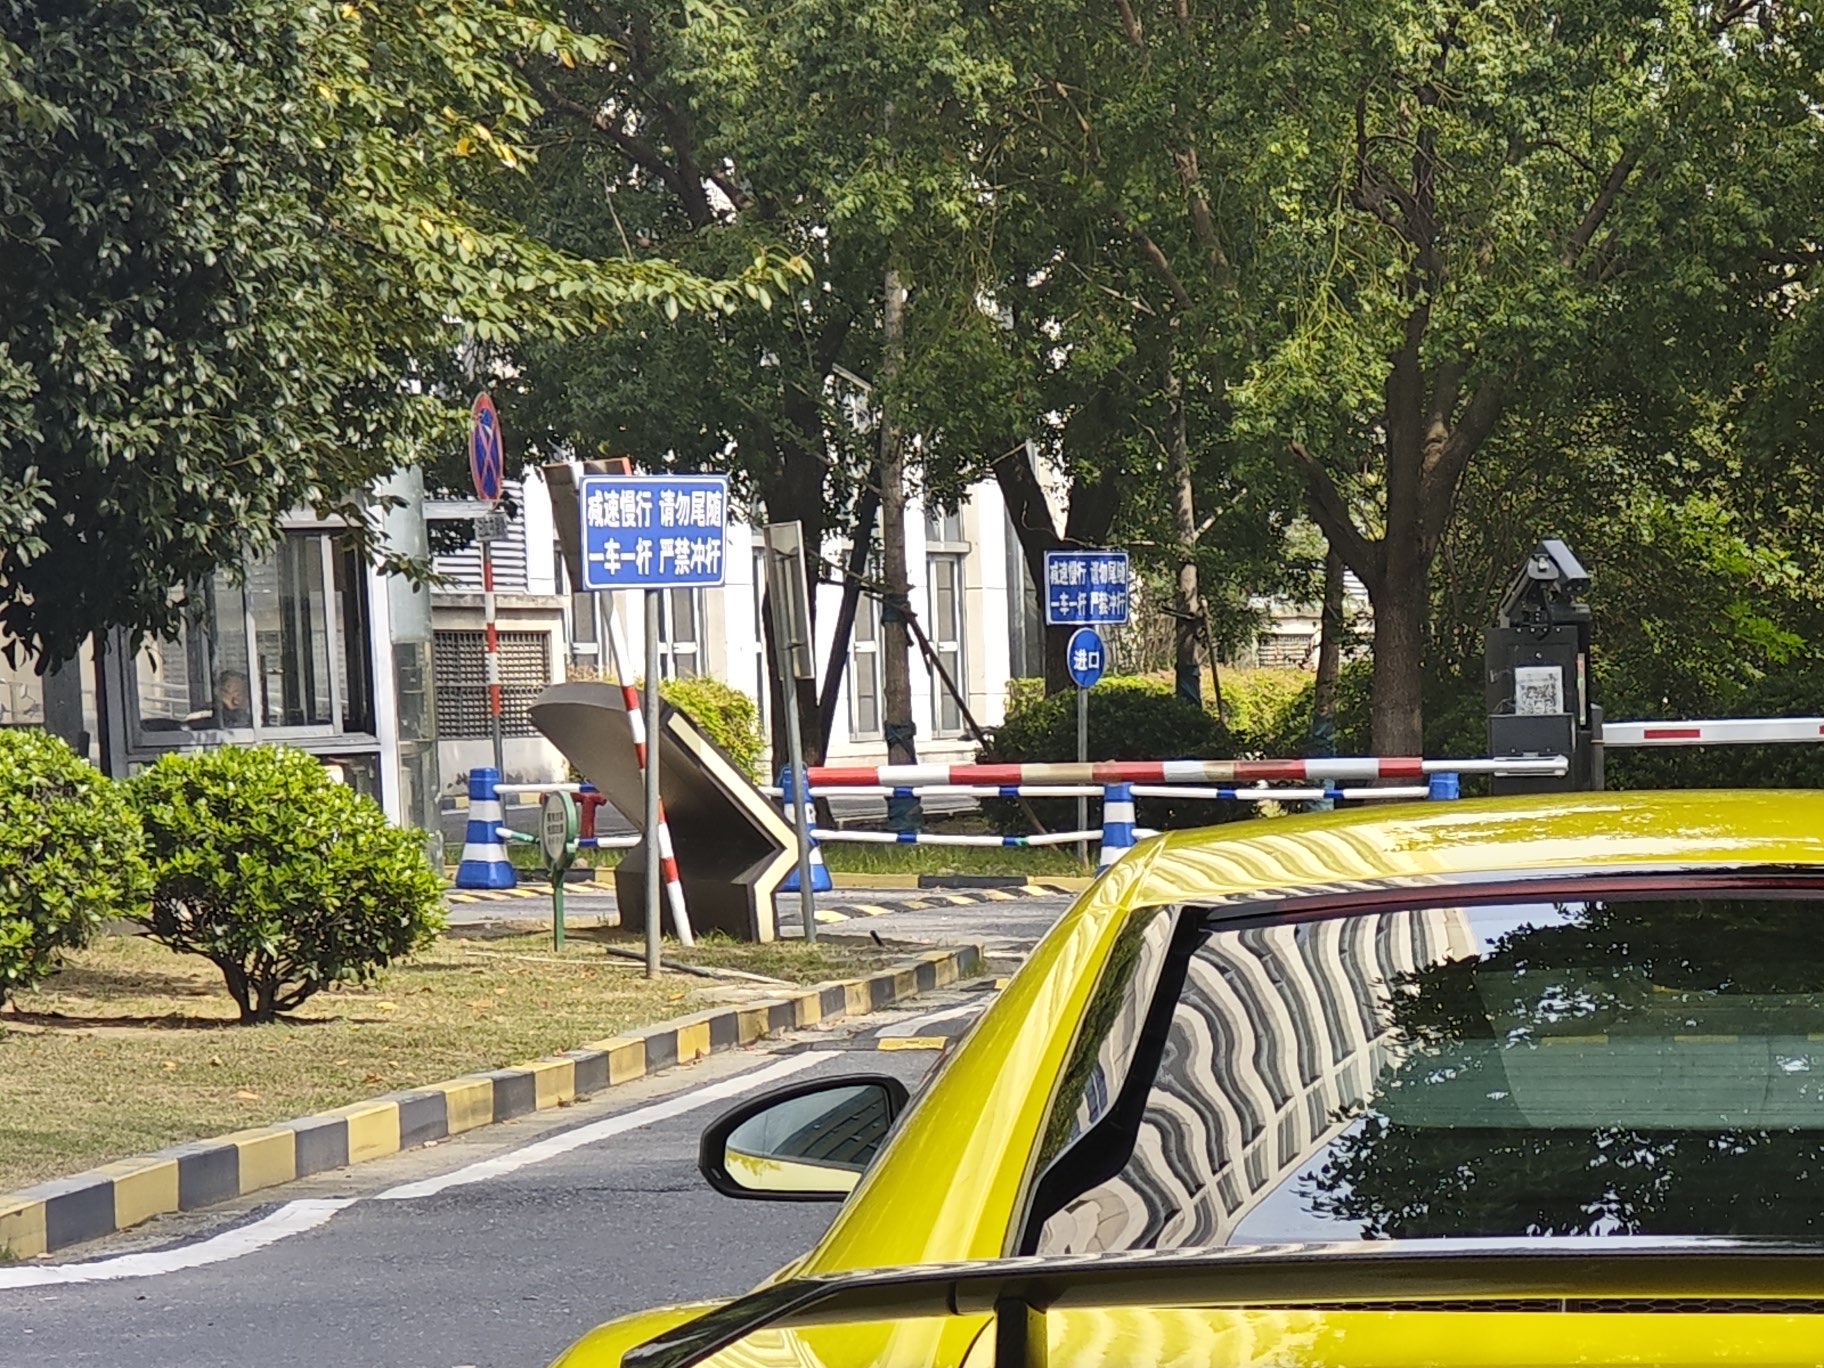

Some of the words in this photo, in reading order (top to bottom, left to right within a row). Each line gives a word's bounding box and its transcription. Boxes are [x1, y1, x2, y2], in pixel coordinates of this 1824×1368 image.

[588, 489, 652, 528] 减速慢行
[659, 489, 722, 528] 请勿尾随
[588, 537, 652, 576] 一车一杆
[659, 537, 721, 576] 严禁冲杆
[1073, 648, 1100, 671] 进口
